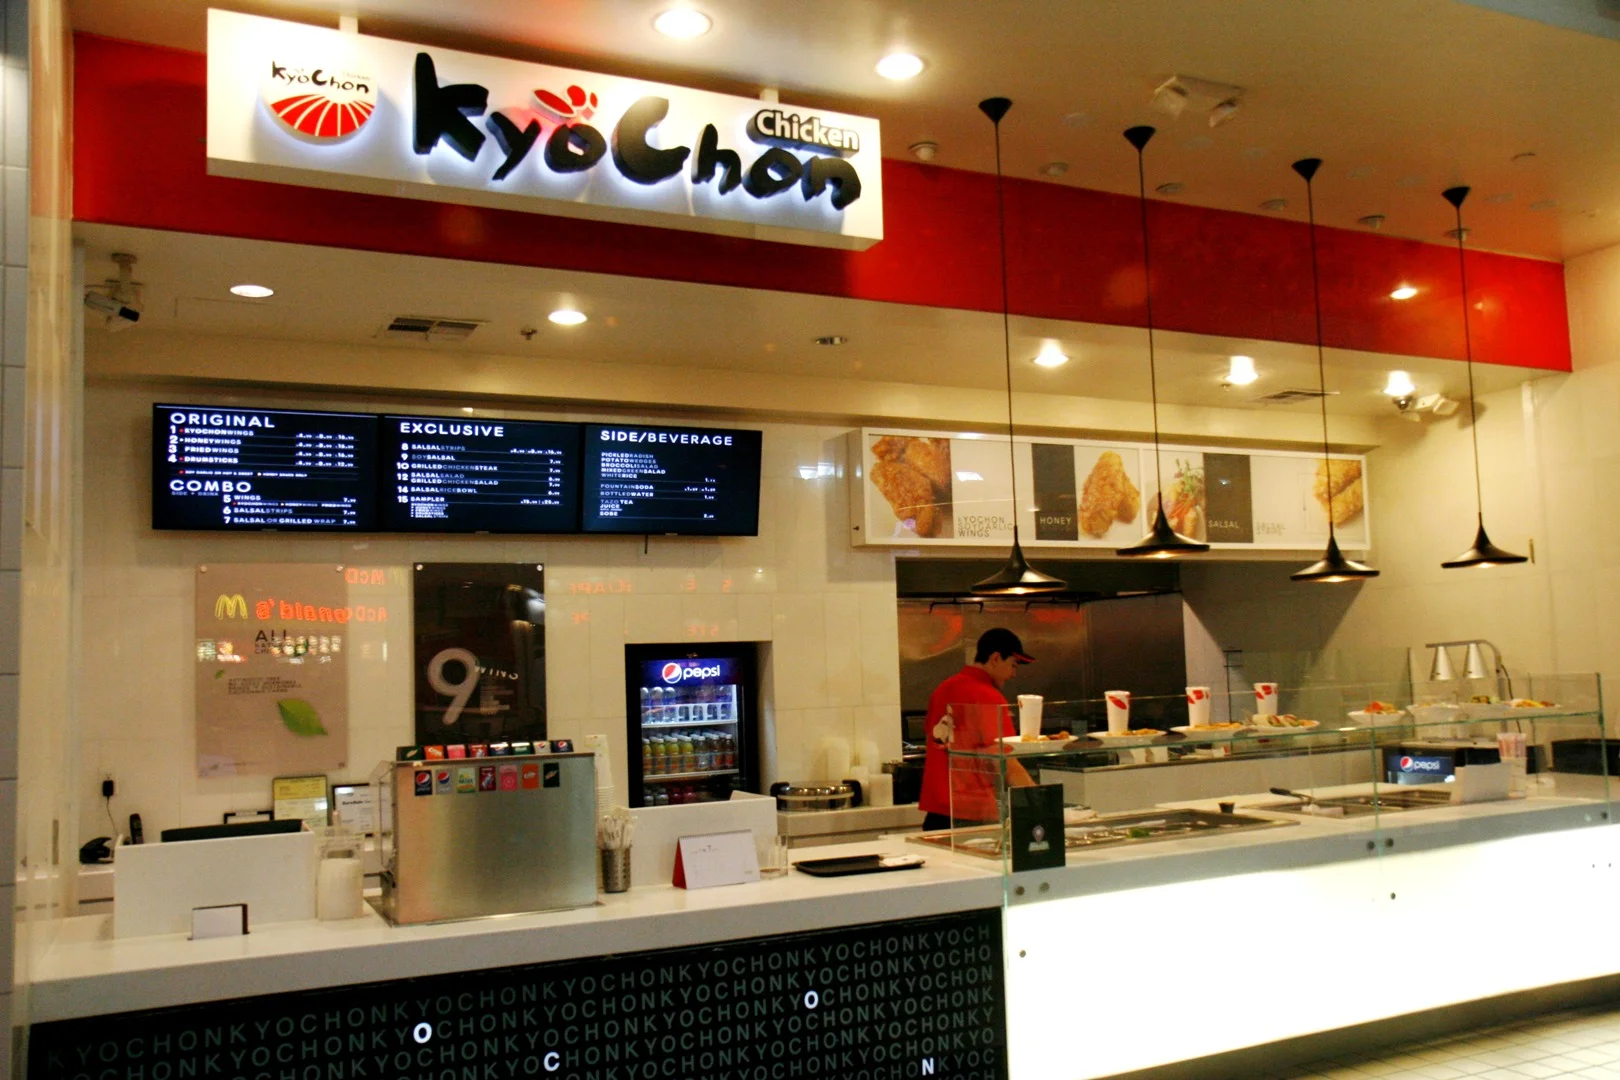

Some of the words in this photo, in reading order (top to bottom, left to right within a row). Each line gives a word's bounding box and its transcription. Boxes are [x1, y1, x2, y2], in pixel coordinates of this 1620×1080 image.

[755, 109, 860, 152] Chicken
[170, 412, 275, 428] ORIGINAL
[170, 425, 177, 434] 1
[400, 422, 504, 437] EXCLUSIVE
[169, 435, 178, 444] 2
[600, 430, 733, 446] SIDE/BEVERAGE
[168, 445, 177, 453] 3
[401, 443, 409, 451] 8
[168, 454, 177, 463] 4
[401, 452, 409, 461] 9
[396, 462, 410, 470] 10
[397, 473, 409, 481] 12
[170, 479, 251, 492] COMBO
[223, 494, 231, 503] 5
[223, 506, 231, 514] 6
[223, 516, 231, 524] 7
[1040, 516, 1072, 526] HONEY
[683, 664, 720, 680] pepsi
[1413, 760, 1440, 771] pepsi
